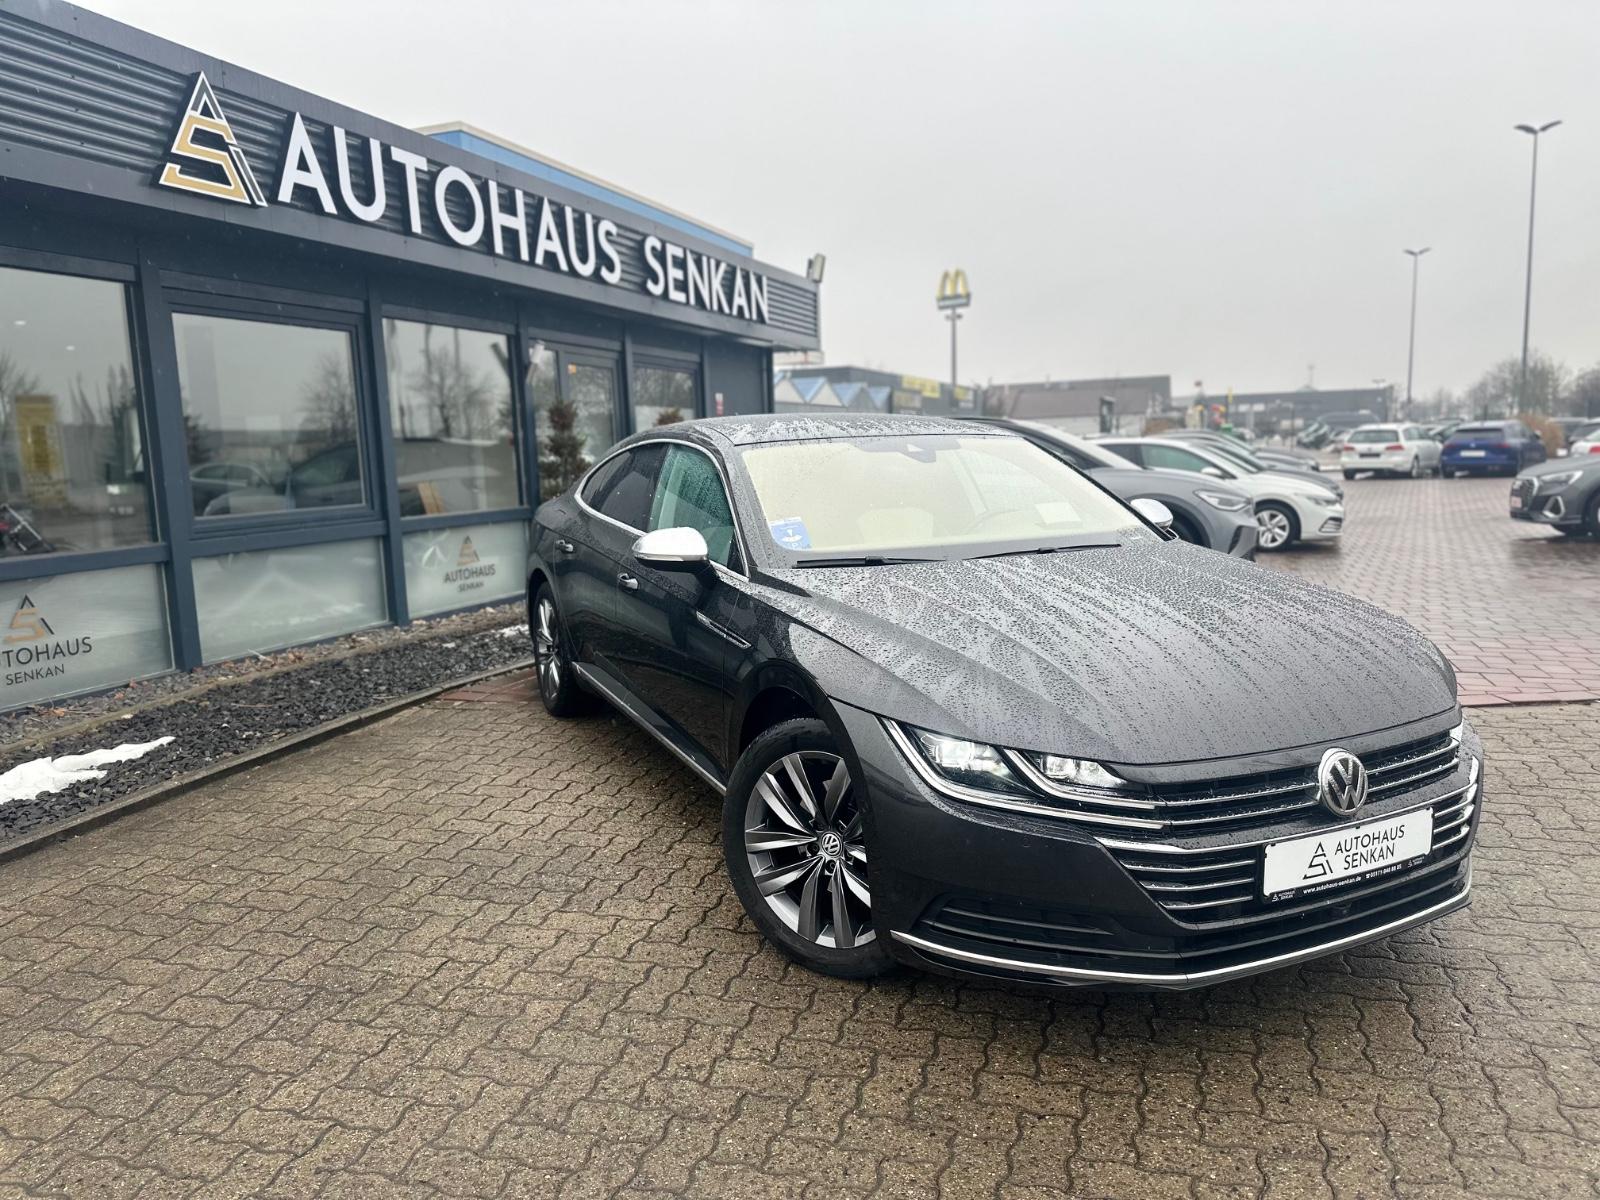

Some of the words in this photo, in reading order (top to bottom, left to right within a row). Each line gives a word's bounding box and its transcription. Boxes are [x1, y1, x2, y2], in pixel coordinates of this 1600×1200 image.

[277, 111, 622, 284] AUTOHAUS
[644, 235, 768, 324] SENKAN
[443, 563, 496, 584] AUTOHAUS
[458, 581, 484, 592] SENKAN
[0, 636, 93, 668] TOHAUS
[6, 664, 65, 686] SENKAN
[1334, 824, 1405, 856] AUTOHAUS
[1343, 843, 1395, 871] SENKAN
